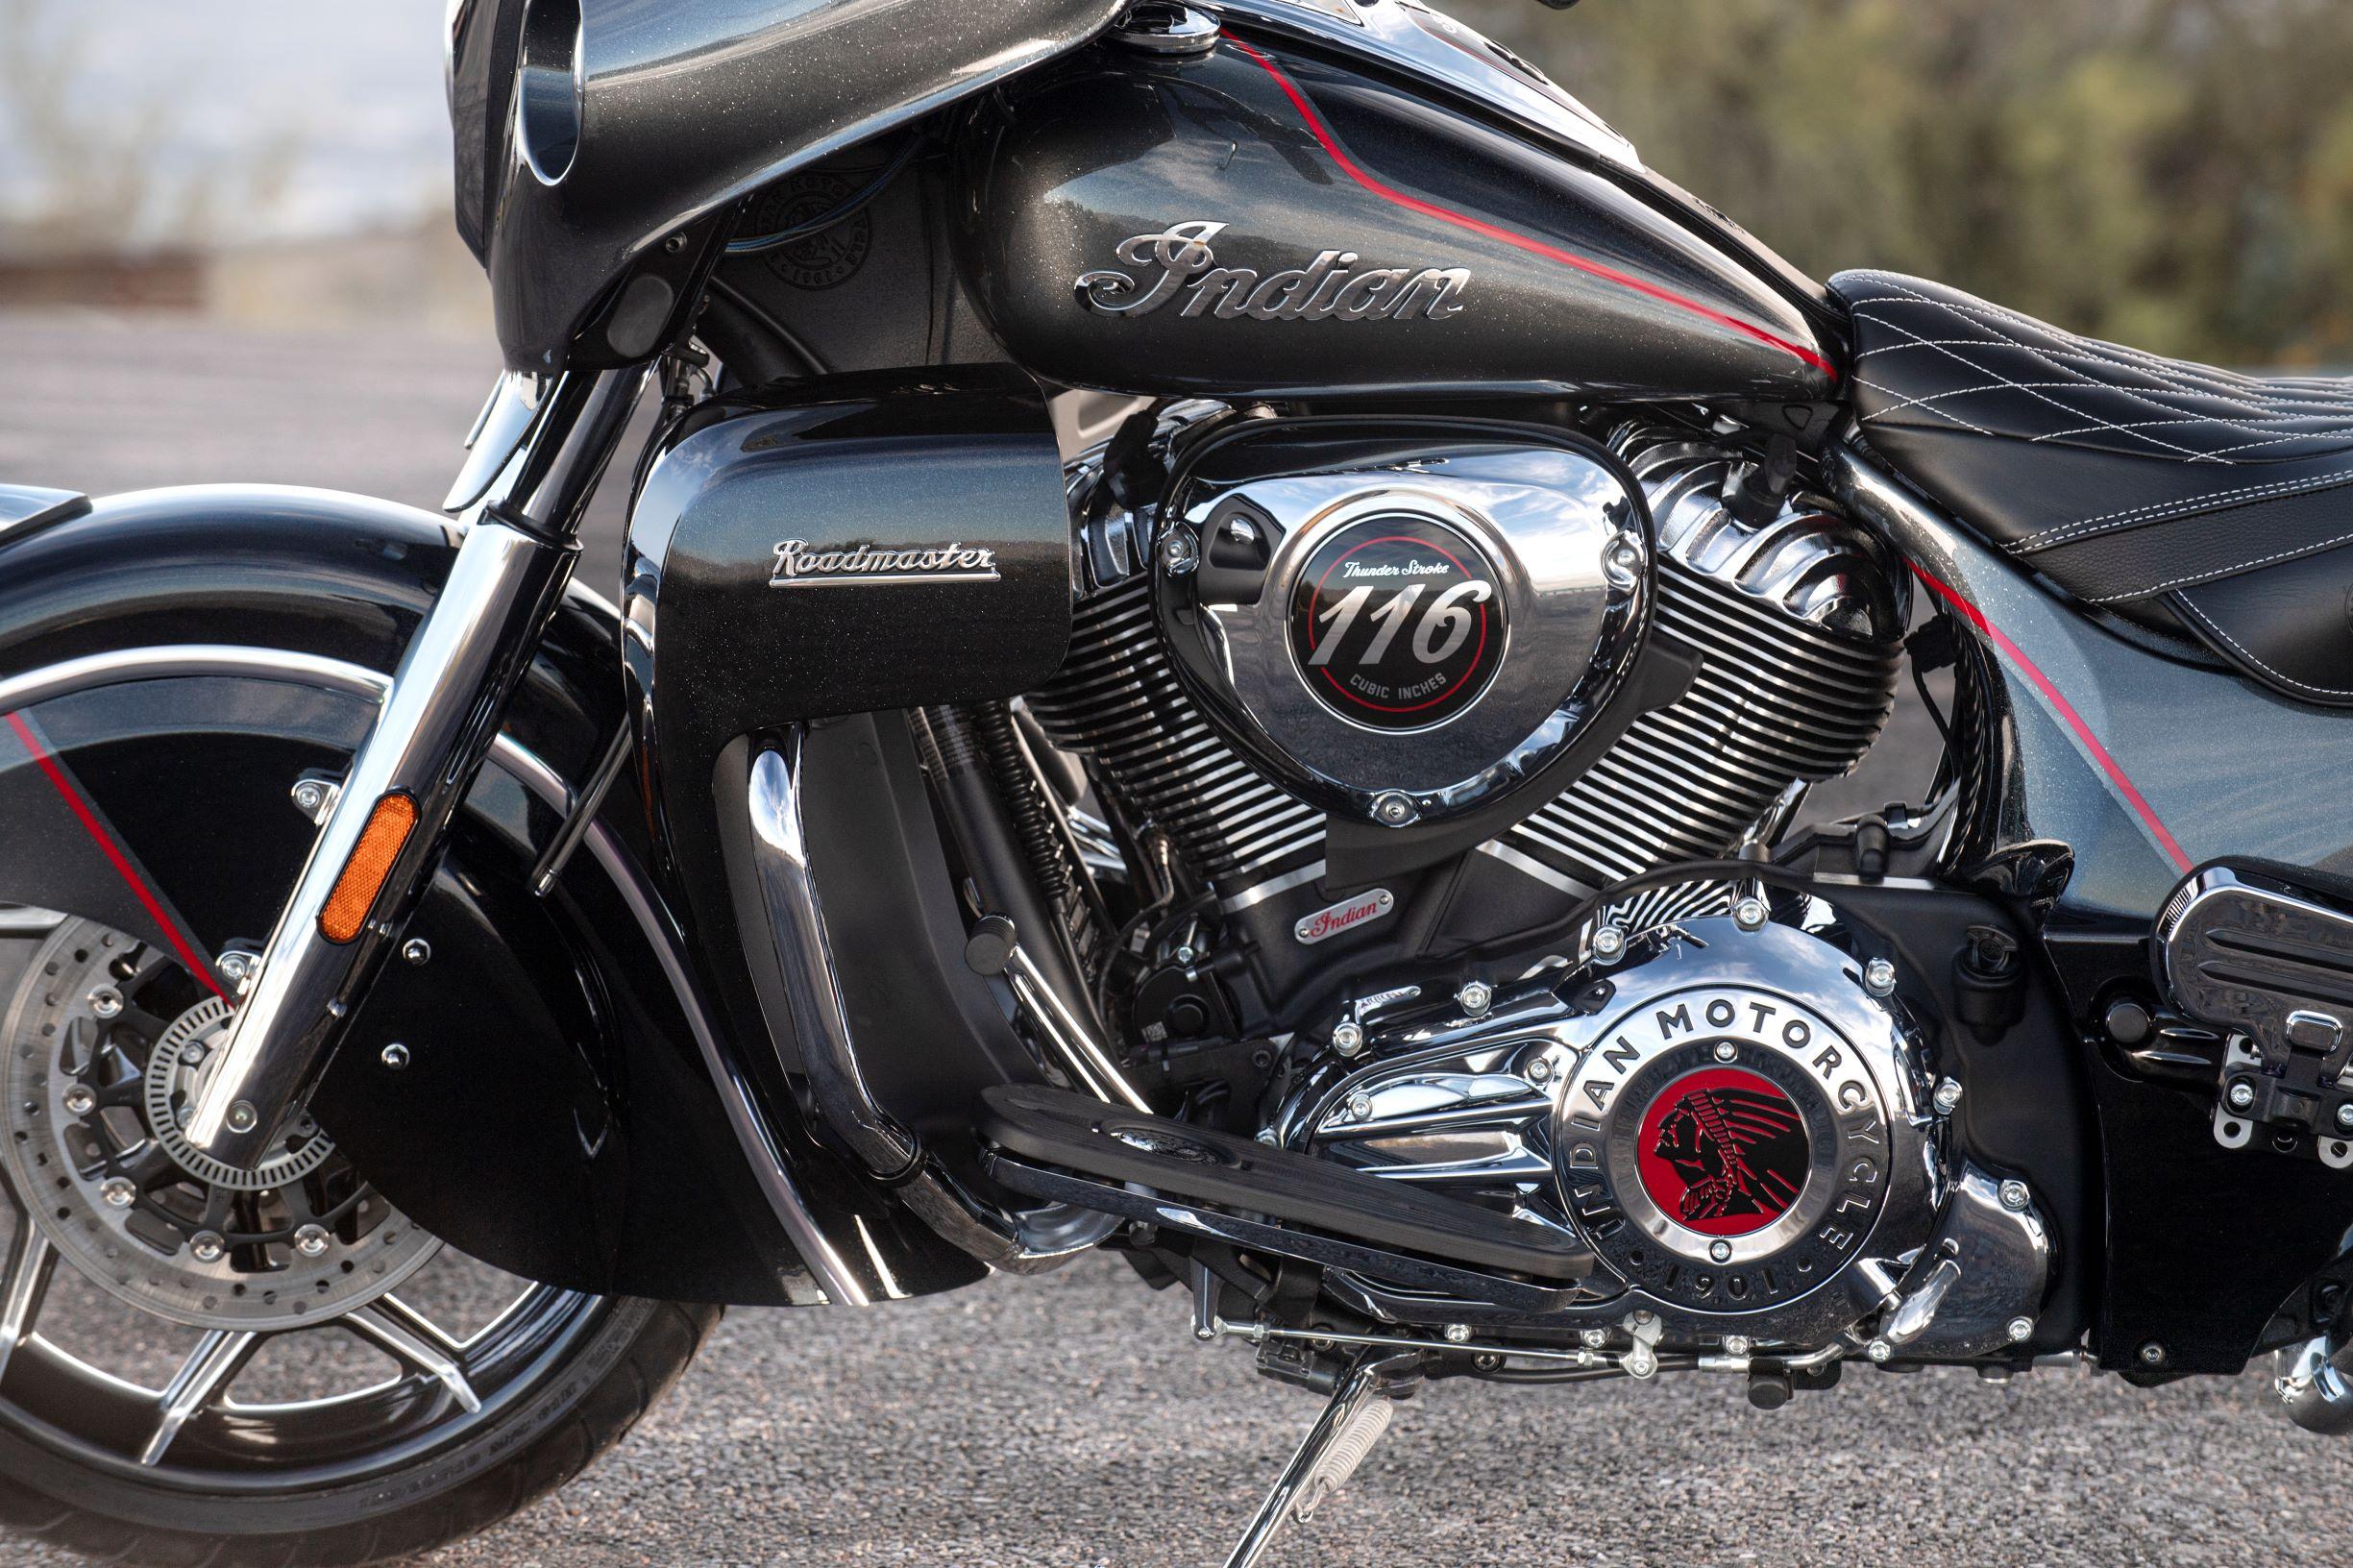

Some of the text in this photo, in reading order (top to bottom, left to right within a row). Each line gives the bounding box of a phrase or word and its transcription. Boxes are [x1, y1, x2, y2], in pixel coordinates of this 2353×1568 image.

[1073, 220, 1472, 321] Indian
[772, 538, 996, 576] Roadmaster
[1343, 560, 1450, 577] Thunder Stroke
[1308, 579, 1492, 666] 116
[1349, 673, 1447, 699] CUBIC INCHES
[1310, 901, 1377, 938] Indian
[1569, 998, 1878, 1250] INDIAN MOTORCYCLE
[1664, 1262, 1777, 1301] 1901
